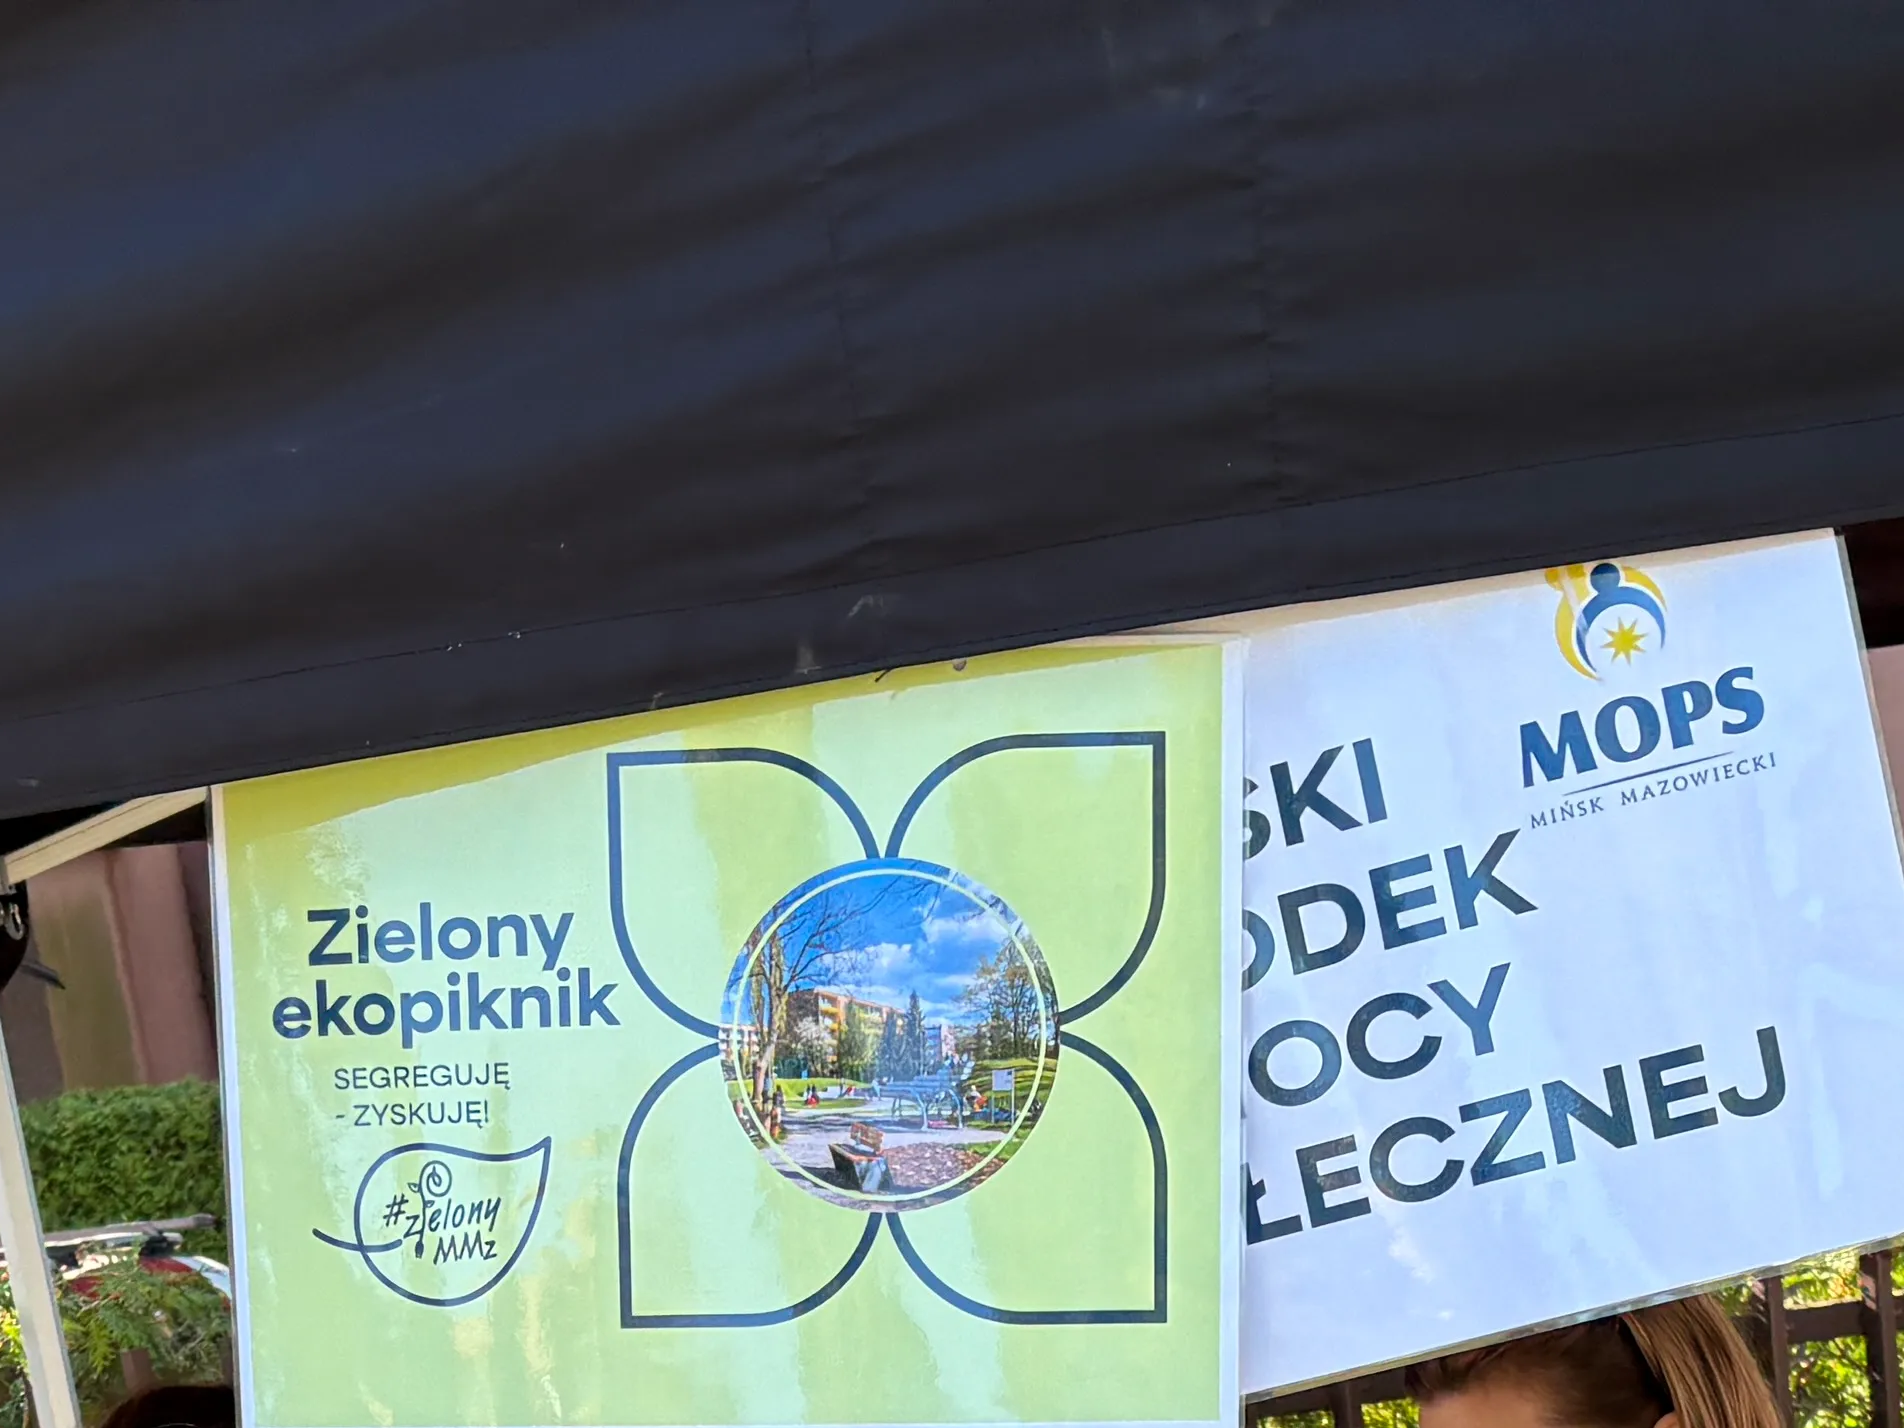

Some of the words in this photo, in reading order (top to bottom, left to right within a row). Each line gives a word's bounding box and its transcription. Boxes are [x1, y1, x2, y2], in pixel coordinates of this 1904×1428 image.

[1520, 665, 1767, 788] MOPS
[1531, 793, 1605, 831] MIŃSK
[1620, 752, 1778, 808] MAZOWIECKI
[307, 902, 574, 972] Zielony
[272, 968, 621, 1049] ekopiknik
[334, 1062, 511, 1091] SEGREGUJĘ
[353, 1099, 489, 1129] ZYSKUJĘ!
